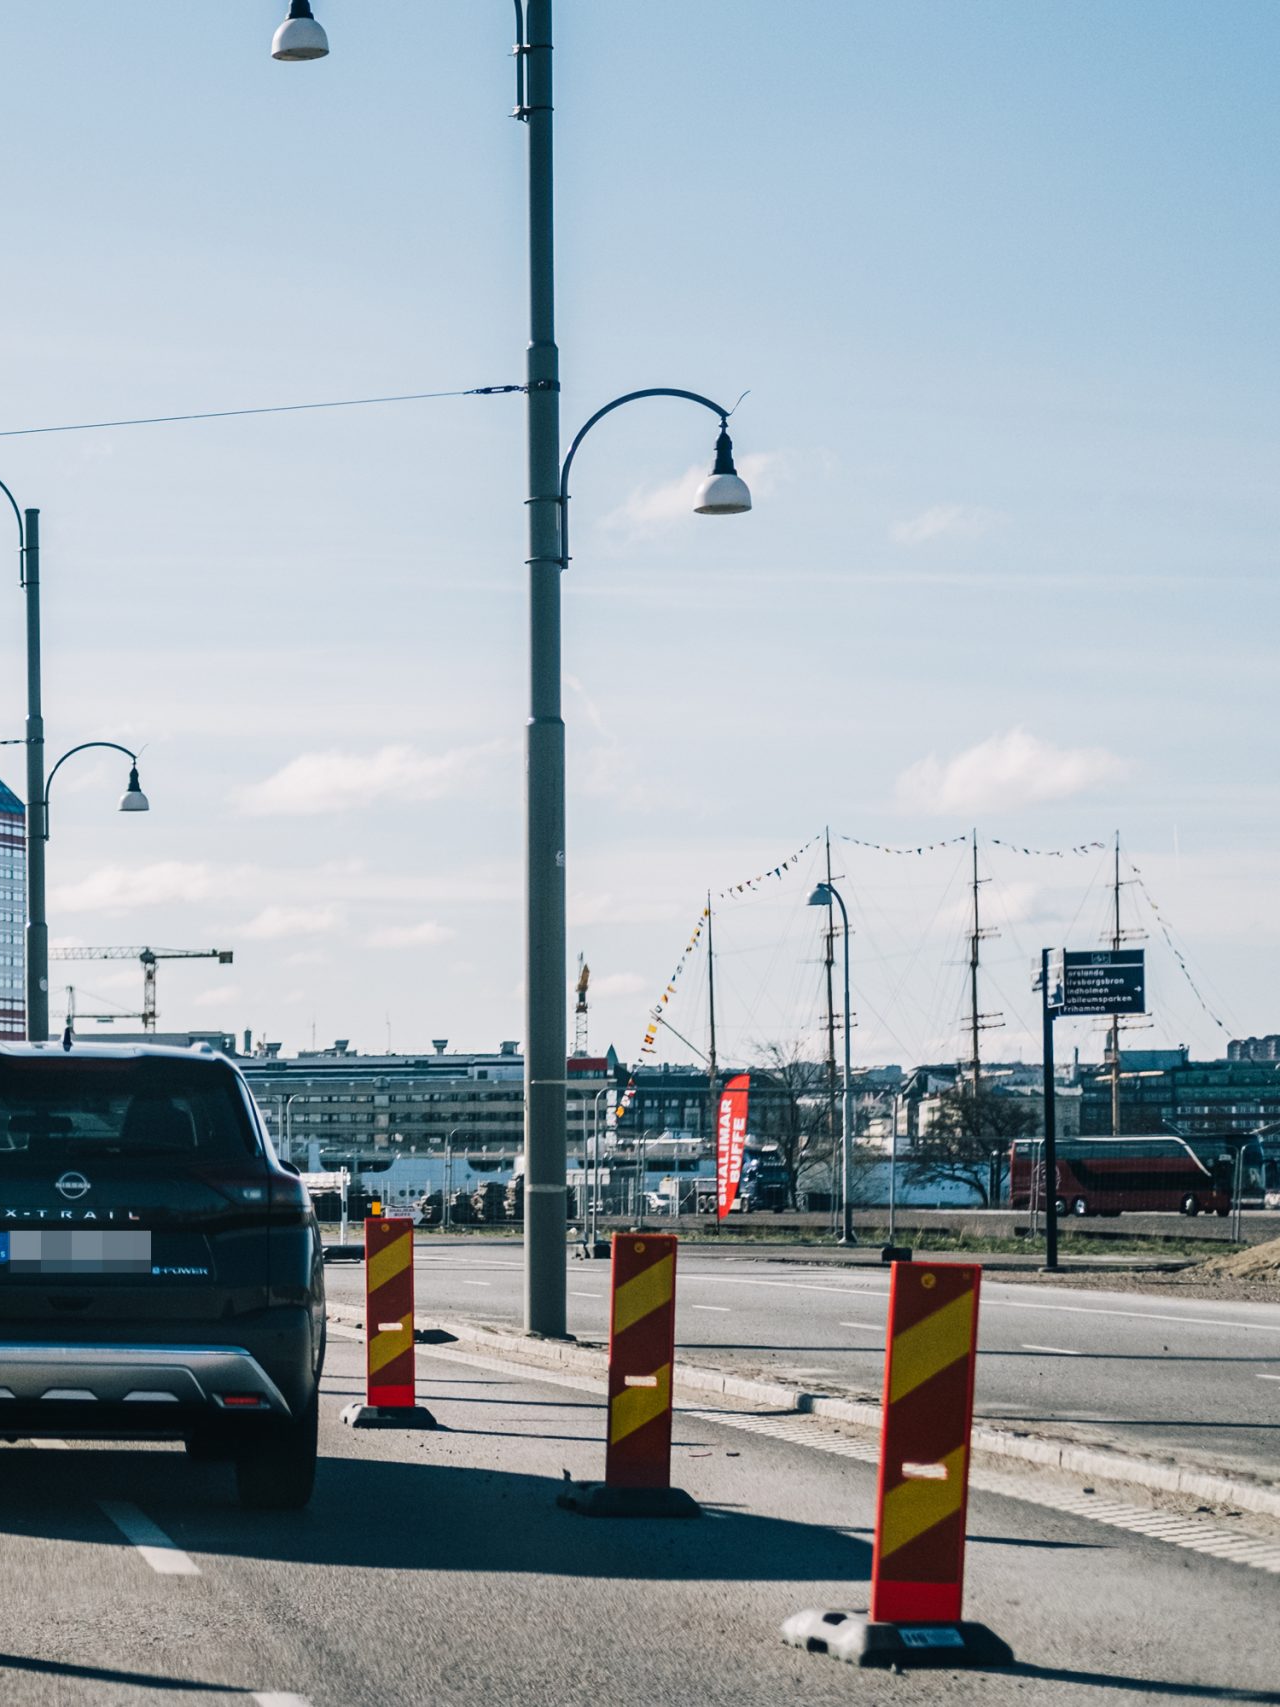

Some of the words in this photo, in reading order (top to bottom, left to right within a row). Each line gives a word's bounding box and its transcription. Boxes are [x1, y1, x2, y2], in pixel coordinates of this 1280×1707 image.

[1067, 969, 1104, 977] orslanda
[1066, 977, 1125, 986] lvsborgsbron
[1066, 987, 1109, 995] indholmen
[1066, 995, 1132, 1004] ubileumsparken
[718, 1099, 733, 1206] SHALIMAR
[730, 1117, 746, 1183] BUFFE
[5, 1209, 140, 1221] X-TRAIL
[0, 1250, 6, 1258] S
